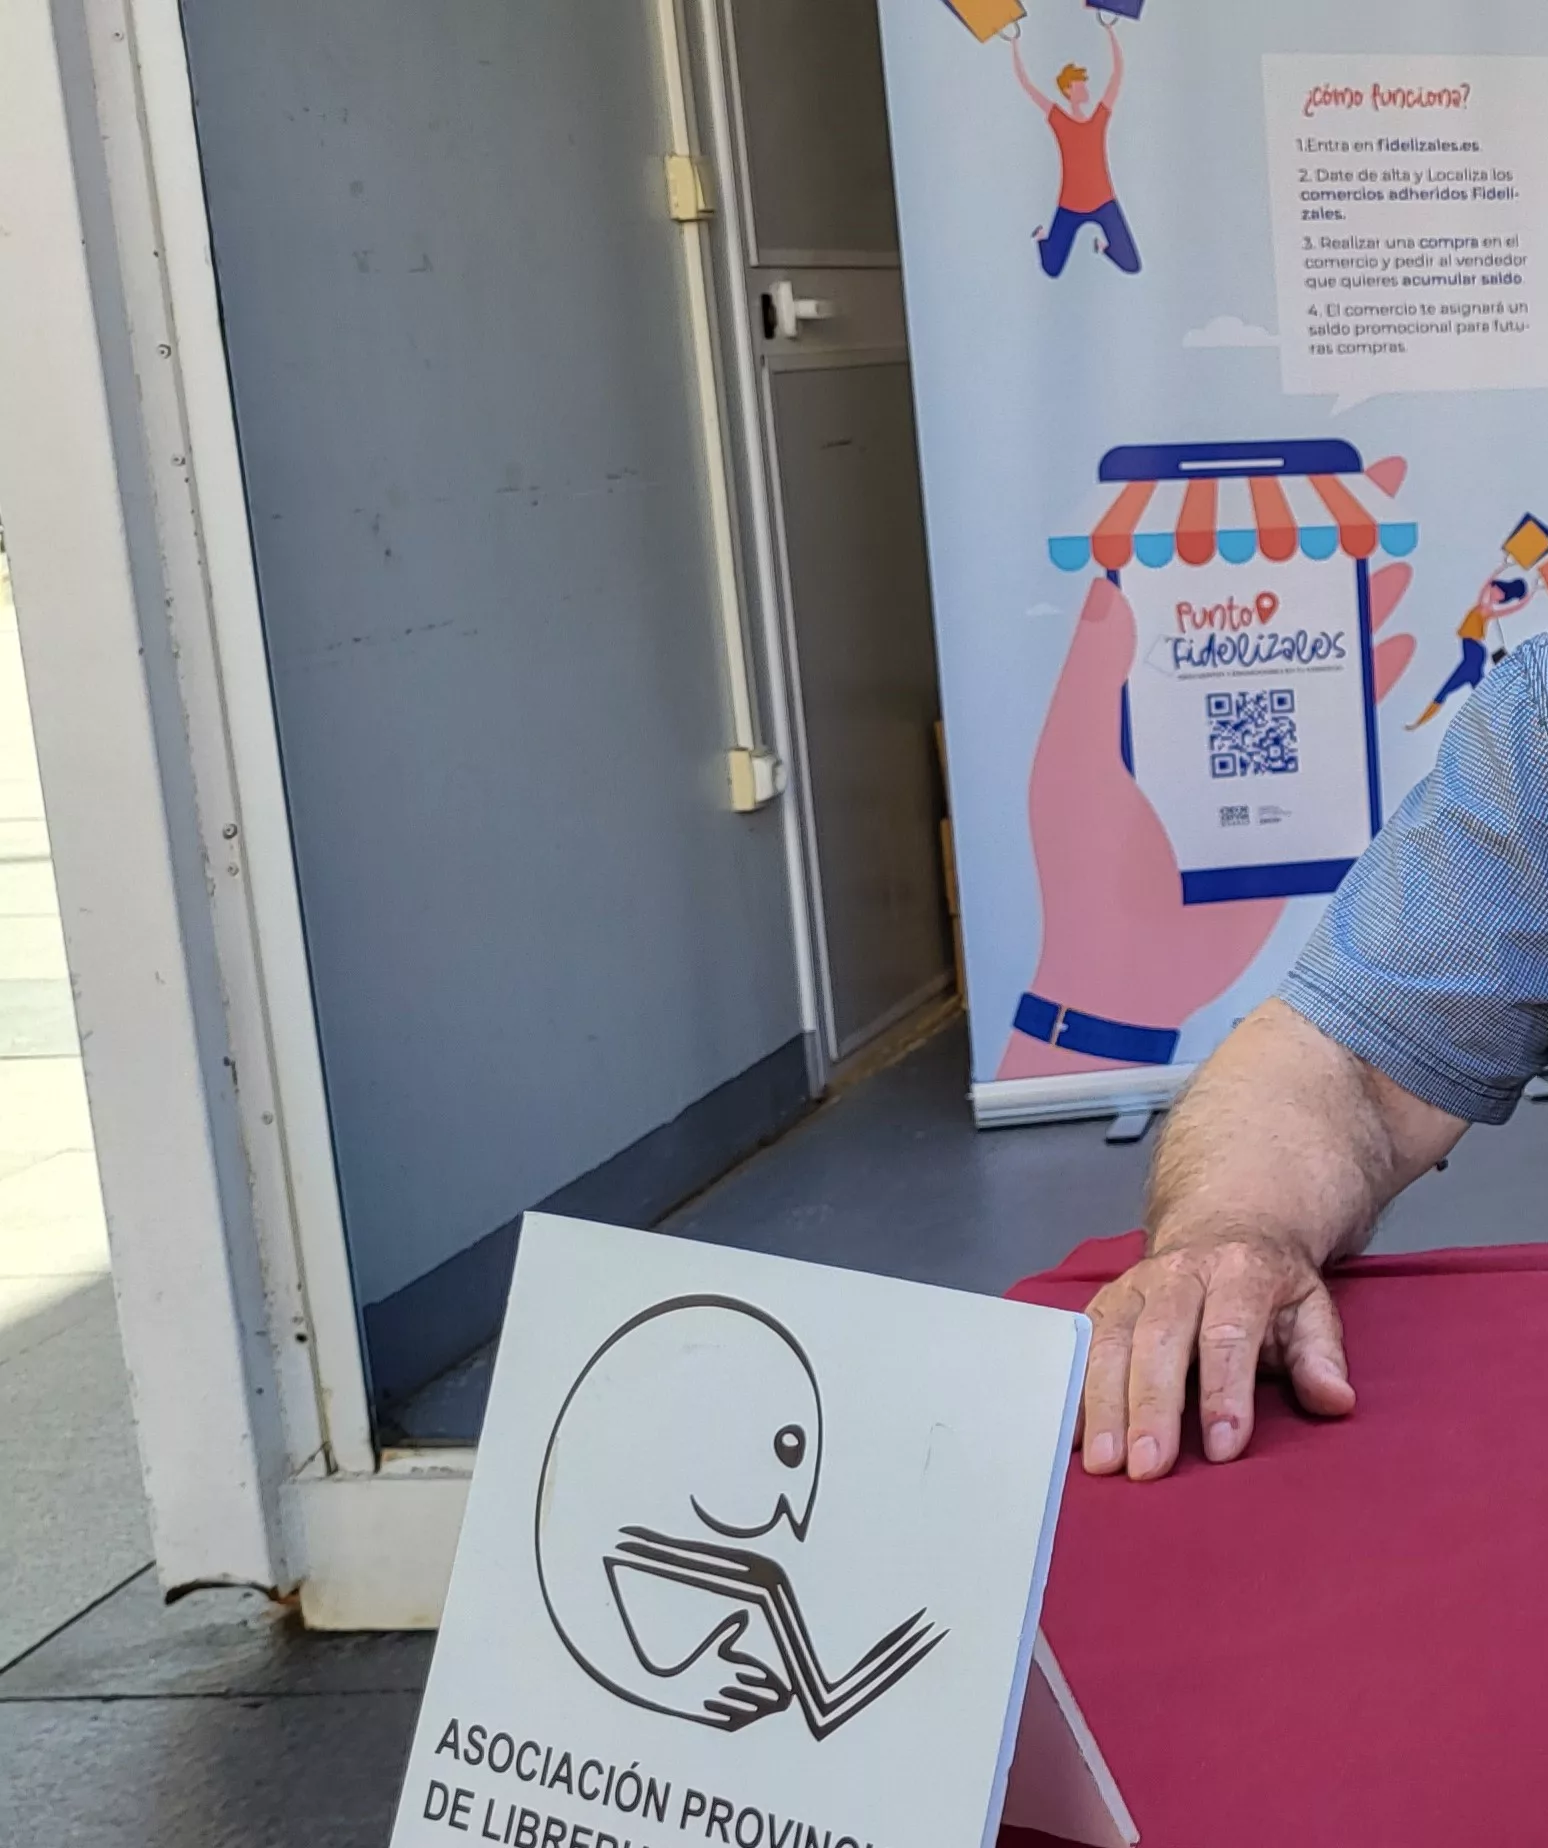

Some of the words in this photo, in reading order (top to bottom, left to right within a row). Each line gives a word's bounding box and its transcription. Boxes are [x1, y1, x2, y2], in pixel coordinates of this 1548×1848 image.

[1372, 83, 1471, 111] funciona?
[1353, 141, 1374, 152] en
[1316, 169, 1354, 182] Date
[1358, 168, 1378, 182] de
[1382, 168, 1410, 182] alta
[1414, 172, 1423, 185] y
[1428, 168, 1488, 181] Localiza
[1492, 168, 1513, 181] los
[1300, 188, 1384, 201] comercios
[1389, 187, 1468, 201] adheridos
[1320, 235, 1380, 249] Realizar
[1384, 238, 1415, 249] una
[1419, 237, 1479, 253] compra
[1481, 237, 1502, 248] en
[1506, 234, 1519, 248] el
[1305, 255, 1377, 269] comercio
[1381, 258, 1391, 271] y
[1395, 254, 1434, 272] pedir
[1439, 253, 1451, 267] al
[1456, 252, 1528, 267] vendedor
[1305, 277, 1337, 290] que
[1340, 275, 1398, 290] quieres
[1402, 274, 1476, 287] acumular
[1326, 304, 1341, 317] El
[1345, 302, 1417, 316] comercio
[1420, 304, 1436, 315] te
[1440, 302, 1504, 318] asignará
[1509, 302, 1529, 314] un
[1309, 322, 1350, 337] saldo
[1355, 320, 1452, 339] promocional
[1456, 321, 1490, 336] para
[1309, 343, 1333, 355] ras
[1175, 595, 1253, 634] Punto
[1168, 630, 1347, 670] Fidelizales
[434, 1717, 672, 1823] ASOCIACIÓN
[423, 1779, 476, 1832] DE
